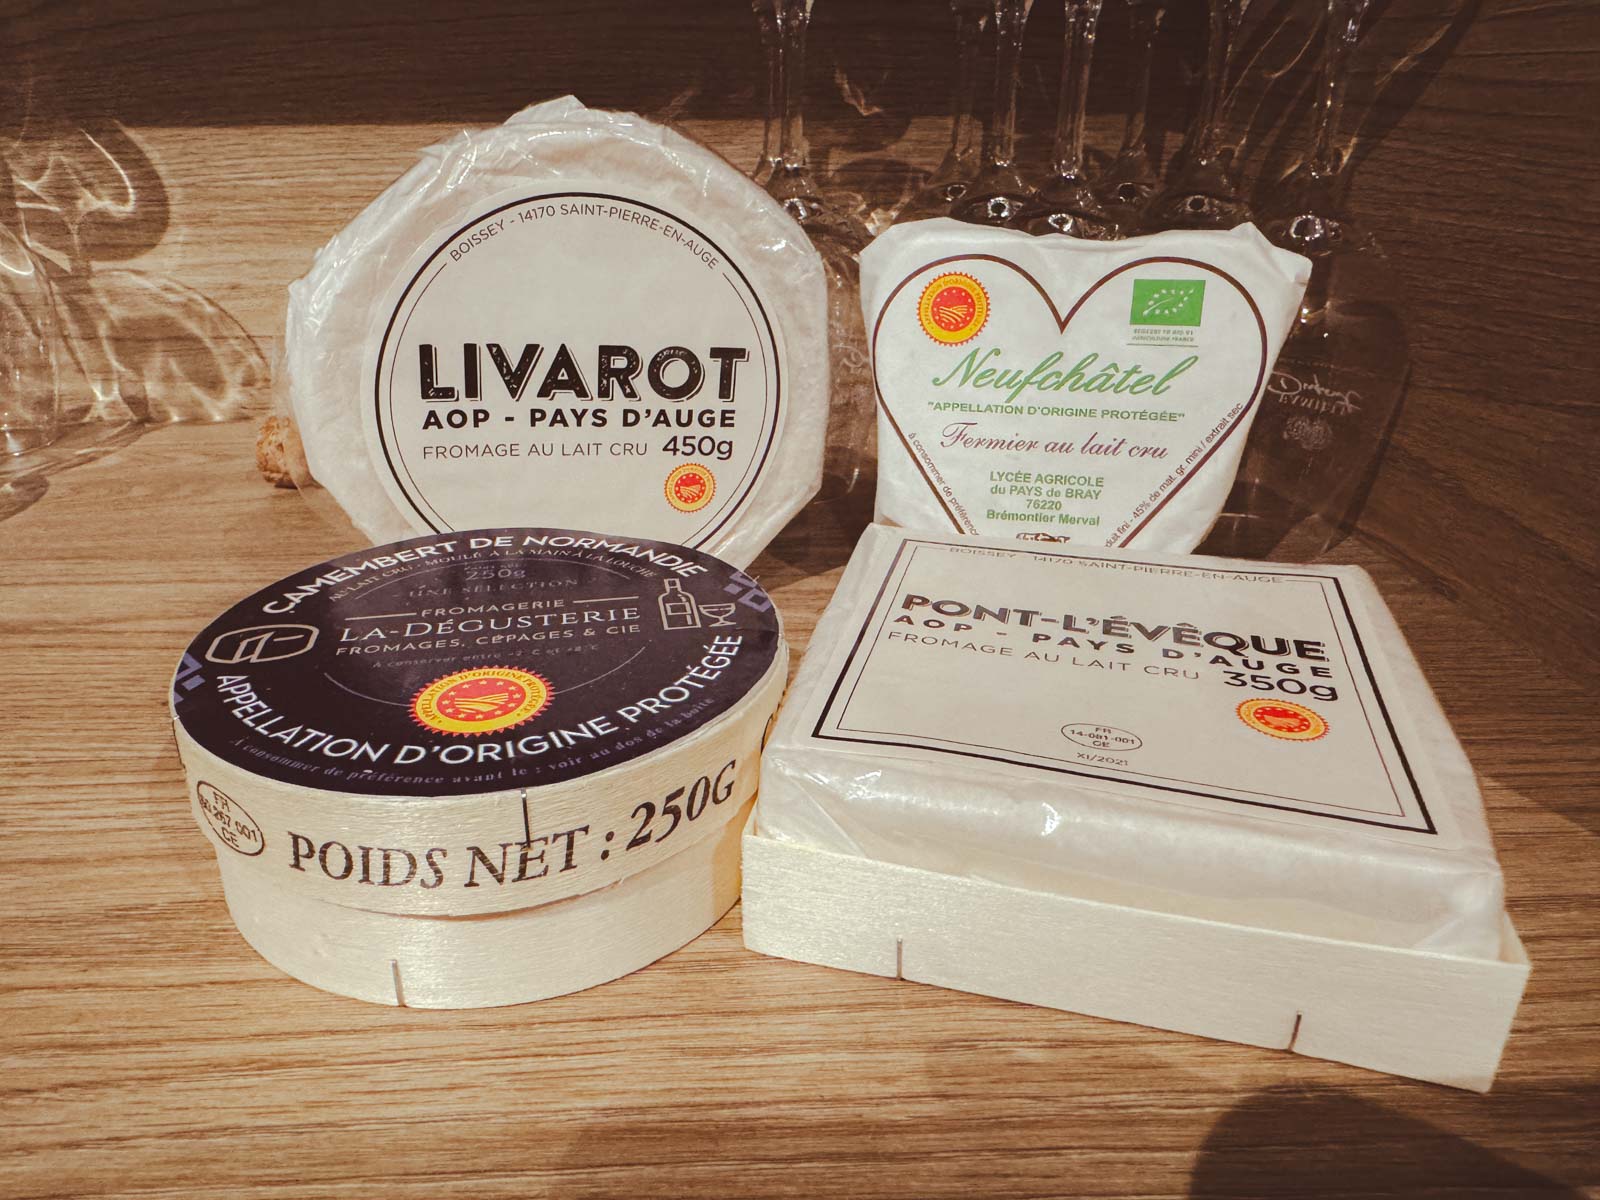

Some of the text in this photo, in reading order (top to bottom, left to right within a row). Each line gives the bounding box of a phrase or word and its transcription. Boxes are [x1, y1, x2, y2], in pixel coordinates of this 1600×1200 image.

[450, 219, 506, 261] BOISSEY
[518, 205, 556, 223] 14170
[560, 203, 719, 269] SAINT-PIERRE-EN-AUGE
[418, 343, 750, 403] LIVAROT
[932, 347, 1199, 404] Neufchâtel
[422, 409, 490, 430] AOP
[530, 408, 608, 428] PAYS
[623, 408, 736, 428] D'AUGE
[928, 401, 1024, 415] "APPELLATION
[1027, 405, 1097, 418] D'ORIGINE
[1205, 418, 1230, 444] extrait
[1229, 402, 1244, 419] sec
[423, 443, 648, 460] FROMAGE AU LAIT CRU
[662, 435, 733, 460] 450g
[940, 422, 1170, 460] Fermier au lait cru
[989, 471, 1104, 488] LYCÉE AGRICOLE
[990, 485, 1101, 500] du PAYS de BRAY
[949, 497, 979, 535] préférenc
[1026, 499, 1062, 511] 76220
[262, 536, 709, 614] CAMEMBERT DE NORMANDIE
[347, 575, 380, 592] LAIT
[530, 548, 570, 556] MAIN
[586, 553, 604, 562] LA
[606, 556, 657, 578] LOUCHE
[465, 570, 526, 581] 250g
[949, 546, 1016, 559] BOISSEY
[1079, 560, 1284, 584] SAINT-PIERRE-EN-AUGE
[340, 607, 641, 642] LA-DÉGUSTERIE
[421, 600, 564, 618] FROMAGERIE
[901, 593, 1330, 662] PONT-L'ÉVÊQUE
[584, 628, 596, 637] &
[607, 625, 641, 634] CIE
[894, 614, 973, 632] AOP
[1032, 633, 1135, 654] PAYS
[1162, 648, 1333, 678] D'AUGE
[888, 631, 1200, 680] FROMAGE AU LAIT CRU
[217, 634, 743, 765] APPELLATION D'ORIGINE PROTÉGÉE
[1223, 670, 1339, 701] 350g
[324, 766, 343, 776] de
[452, 772, 503, 783] avant
[512, 767, 527, 776] le
[549, 756, 583, 770] voir
[592, 748, 611, 759] au
[615, 736, 643, 751] dos
[222, 827, 240, 848] CE
[287, 759, 737, 890] POIDS NET : 250G
